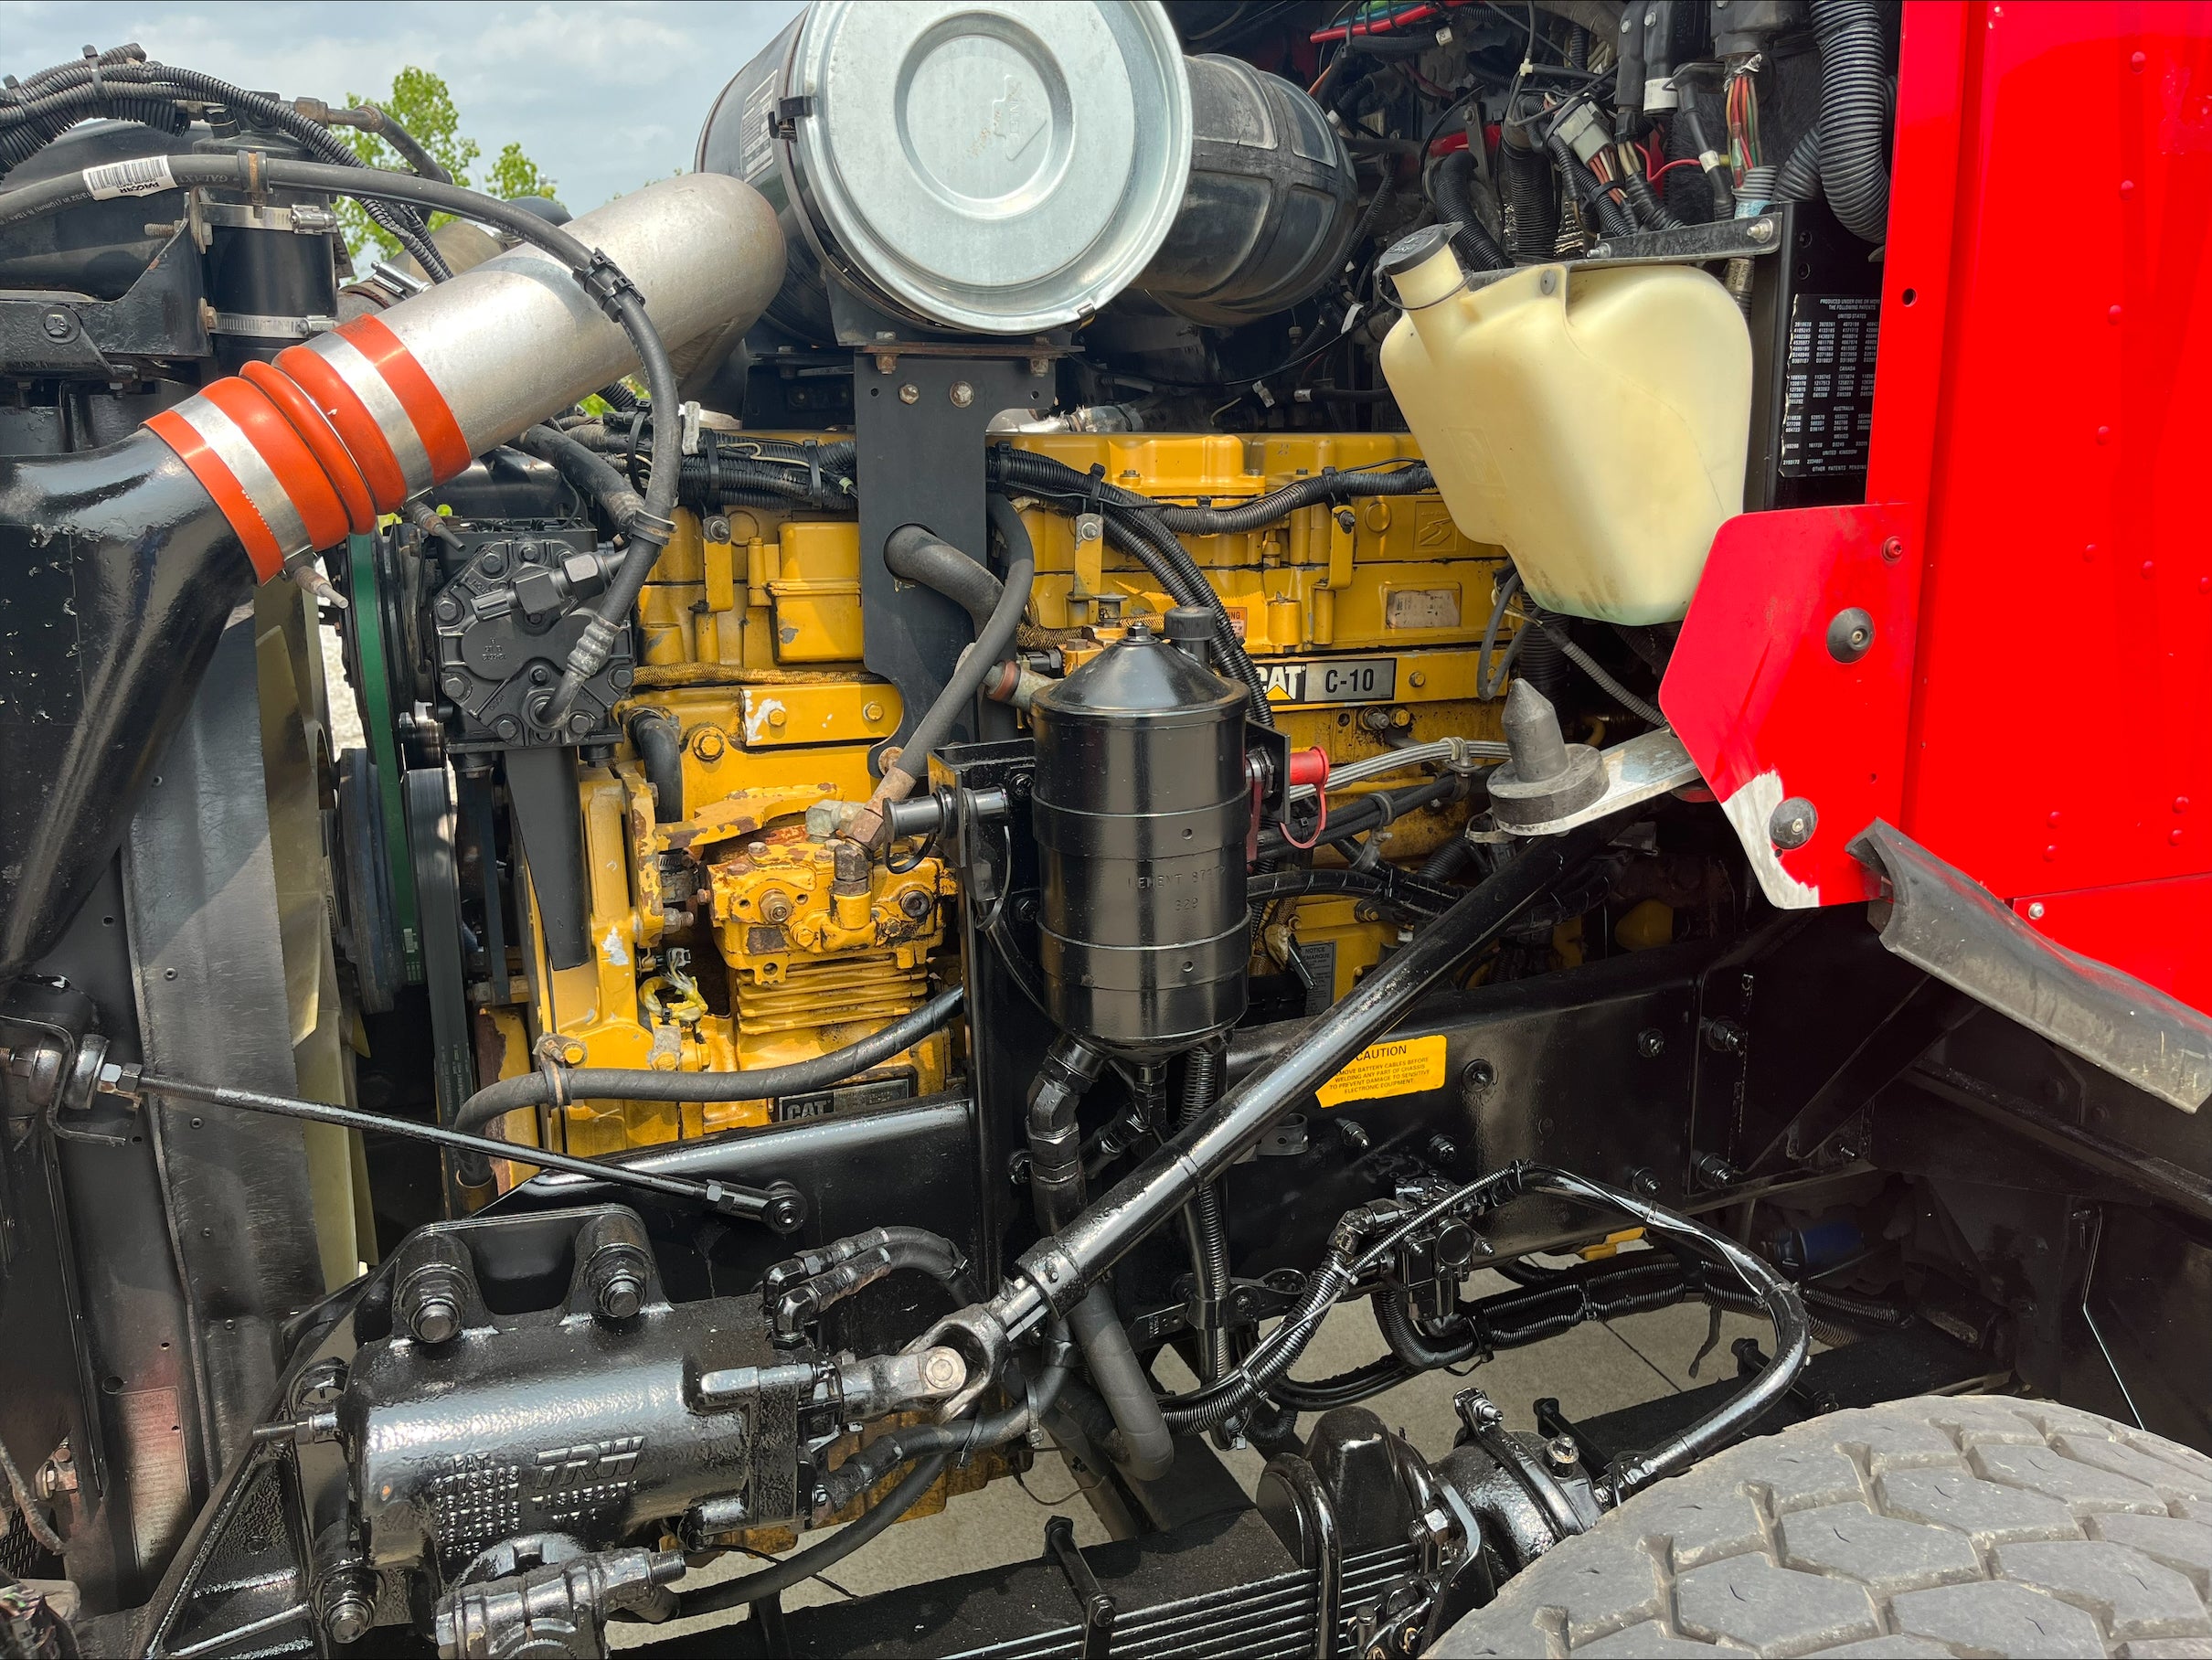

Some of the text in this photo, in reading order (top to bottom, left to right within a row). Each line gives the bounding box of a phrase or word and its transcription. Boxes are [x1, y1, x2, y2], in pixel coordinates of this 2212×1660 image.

[119, 181, 160, 195] PACCAR
[1326, 668, 1375, 694] C-10
[1356, 1044, 1408, 1062] CAUTION
[1335, 1063, 1426, 1083] WELDING ANY PART OF CHASSIS
[1358, 1063, 1384, 1073] BATTERY
[1385, 1059, 1406, 1069] CABLES
[1407, 1056, 1430, 1066] BEFORE
[1329, 1069, 1430, 1091] TO PREVENT DAMAGE TO SENSITIVE
[1345, 1082, 1379, 1094] ELECTRONIC
[535, 1436, 644, 1489] TRW
